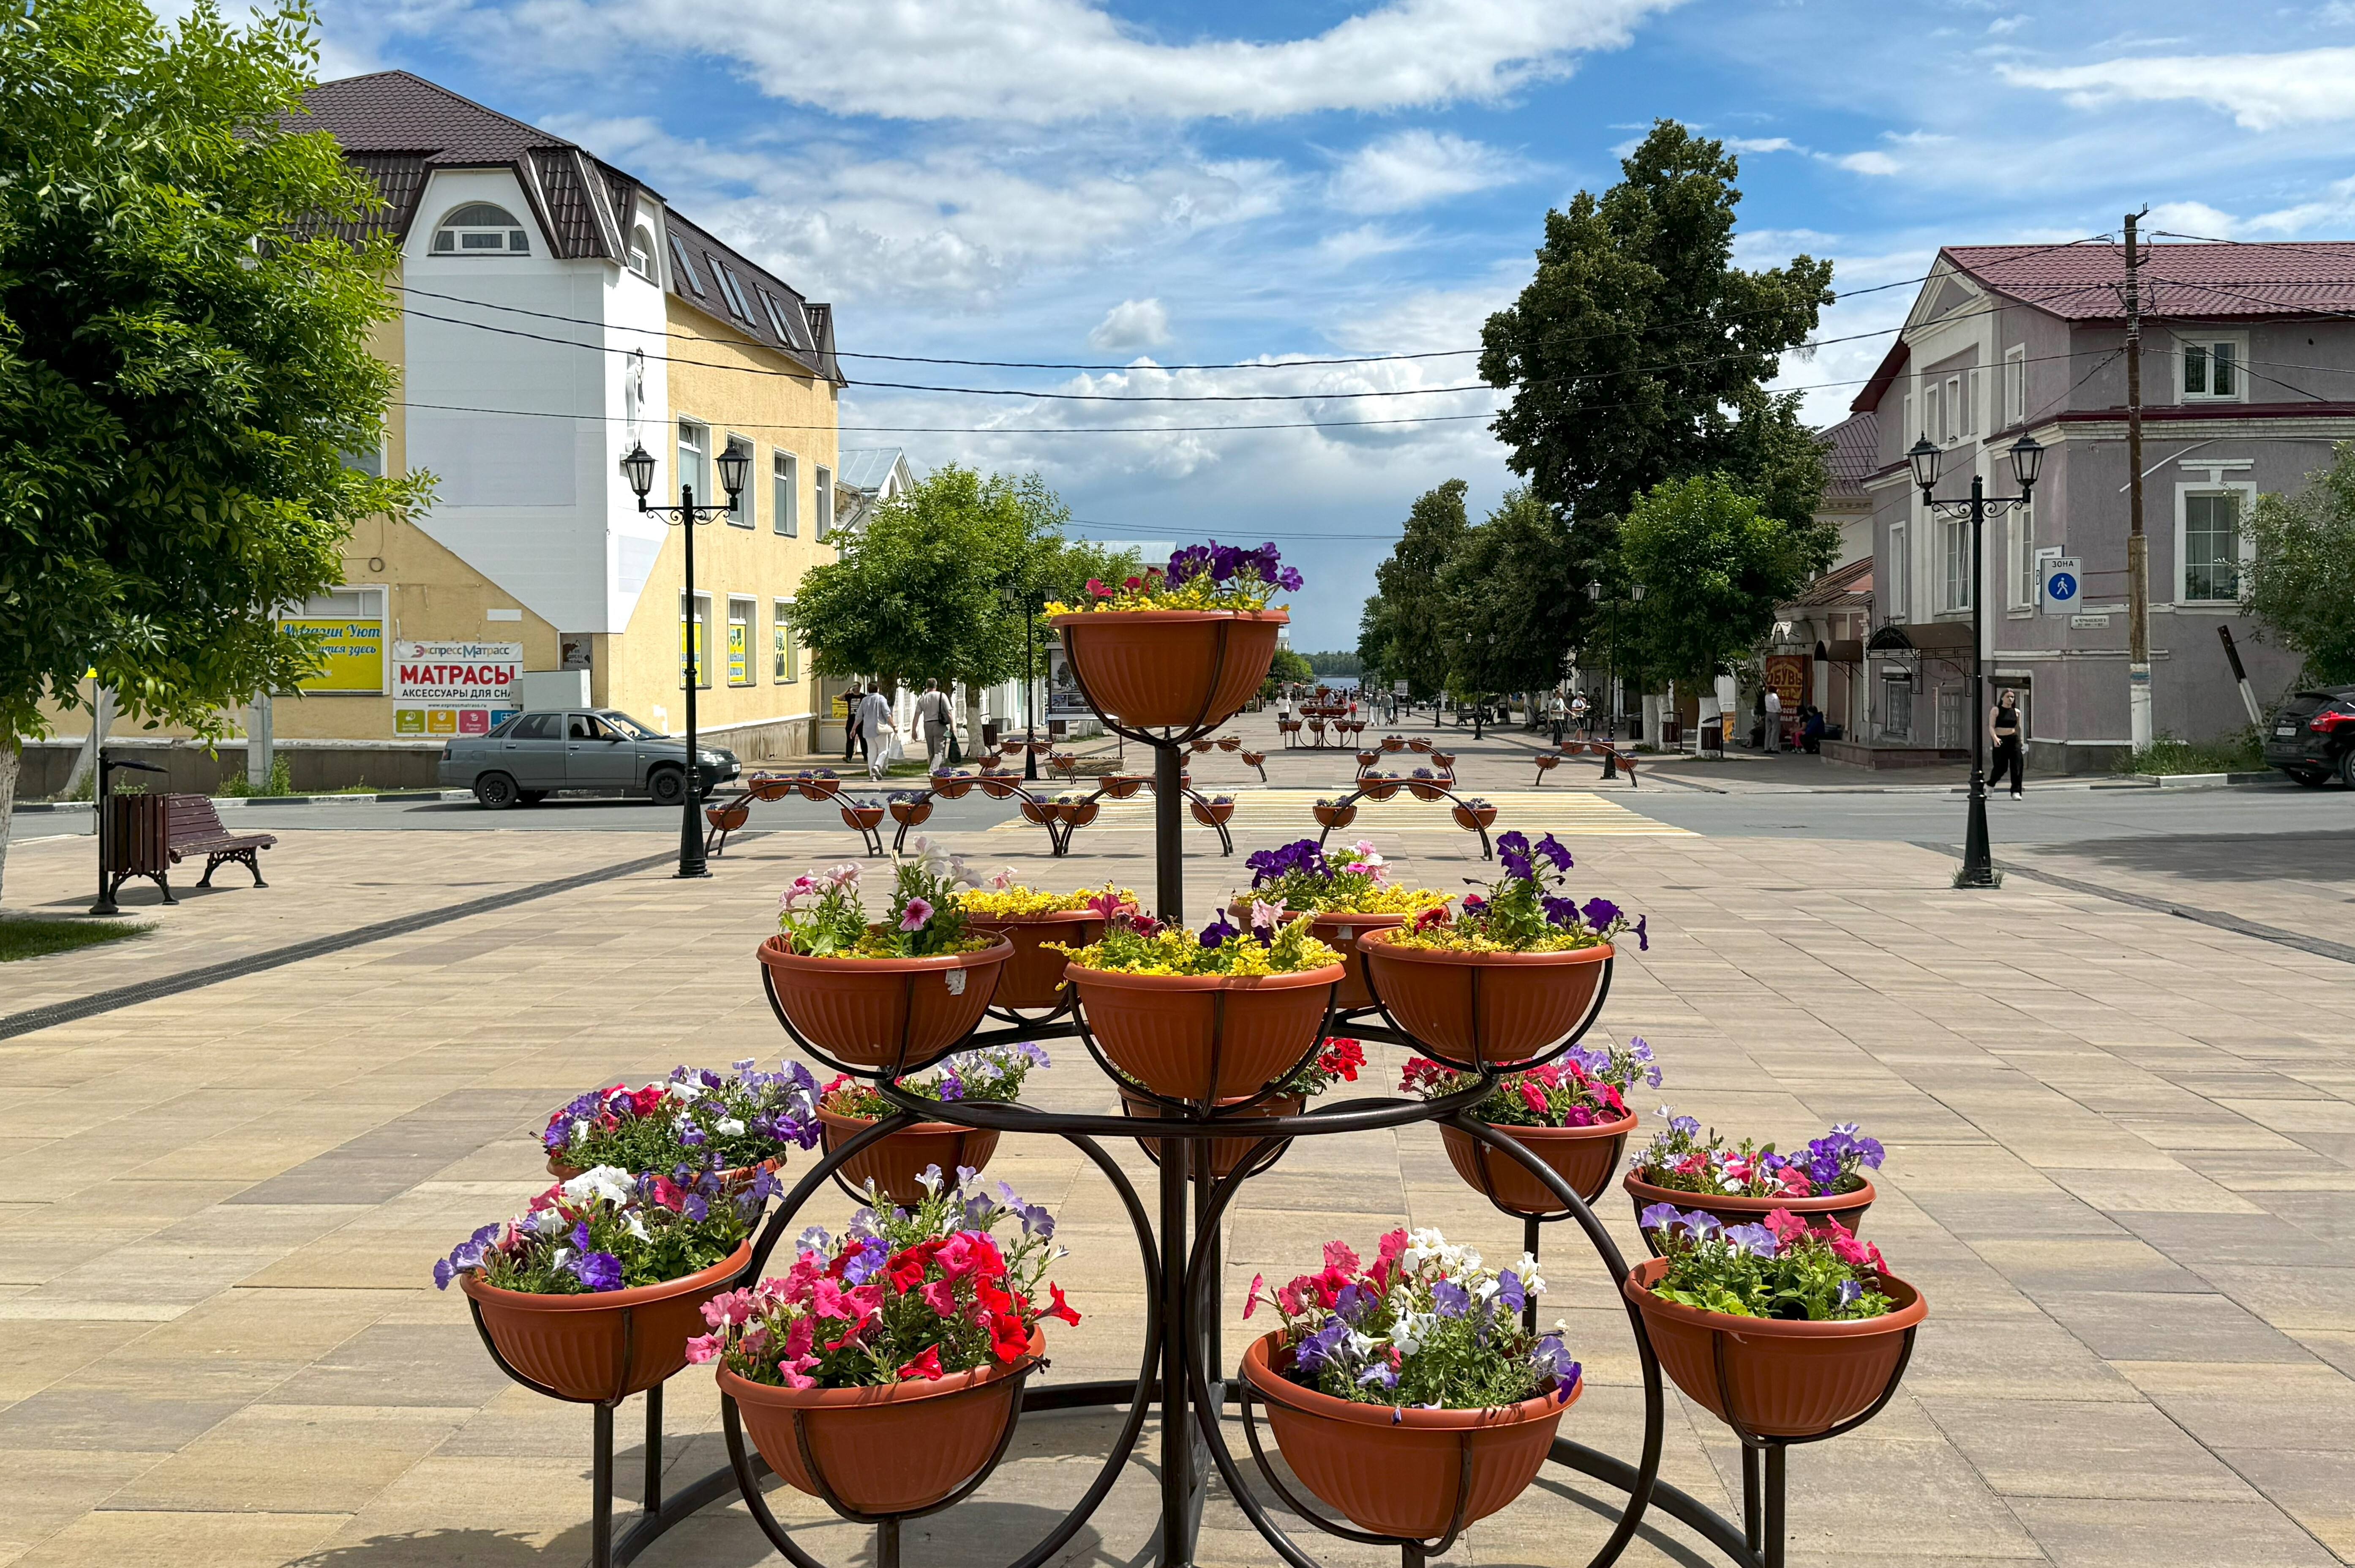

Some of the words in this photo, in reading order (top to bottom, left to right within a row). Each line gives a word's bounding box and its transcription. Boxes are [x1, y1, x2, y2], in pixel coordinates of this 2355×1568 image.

[346, 624, 380, 638] Уют
[347, 646, 376, 657] здесь
[400, 665, 515, 685] МАТРАСЫ
[1766, 668, 1802, 685] ОБУВЬ
[402, 689, 468, 698] АКСЕССУАРЫ
[470, 689, 491, 698] ДЛЯ
